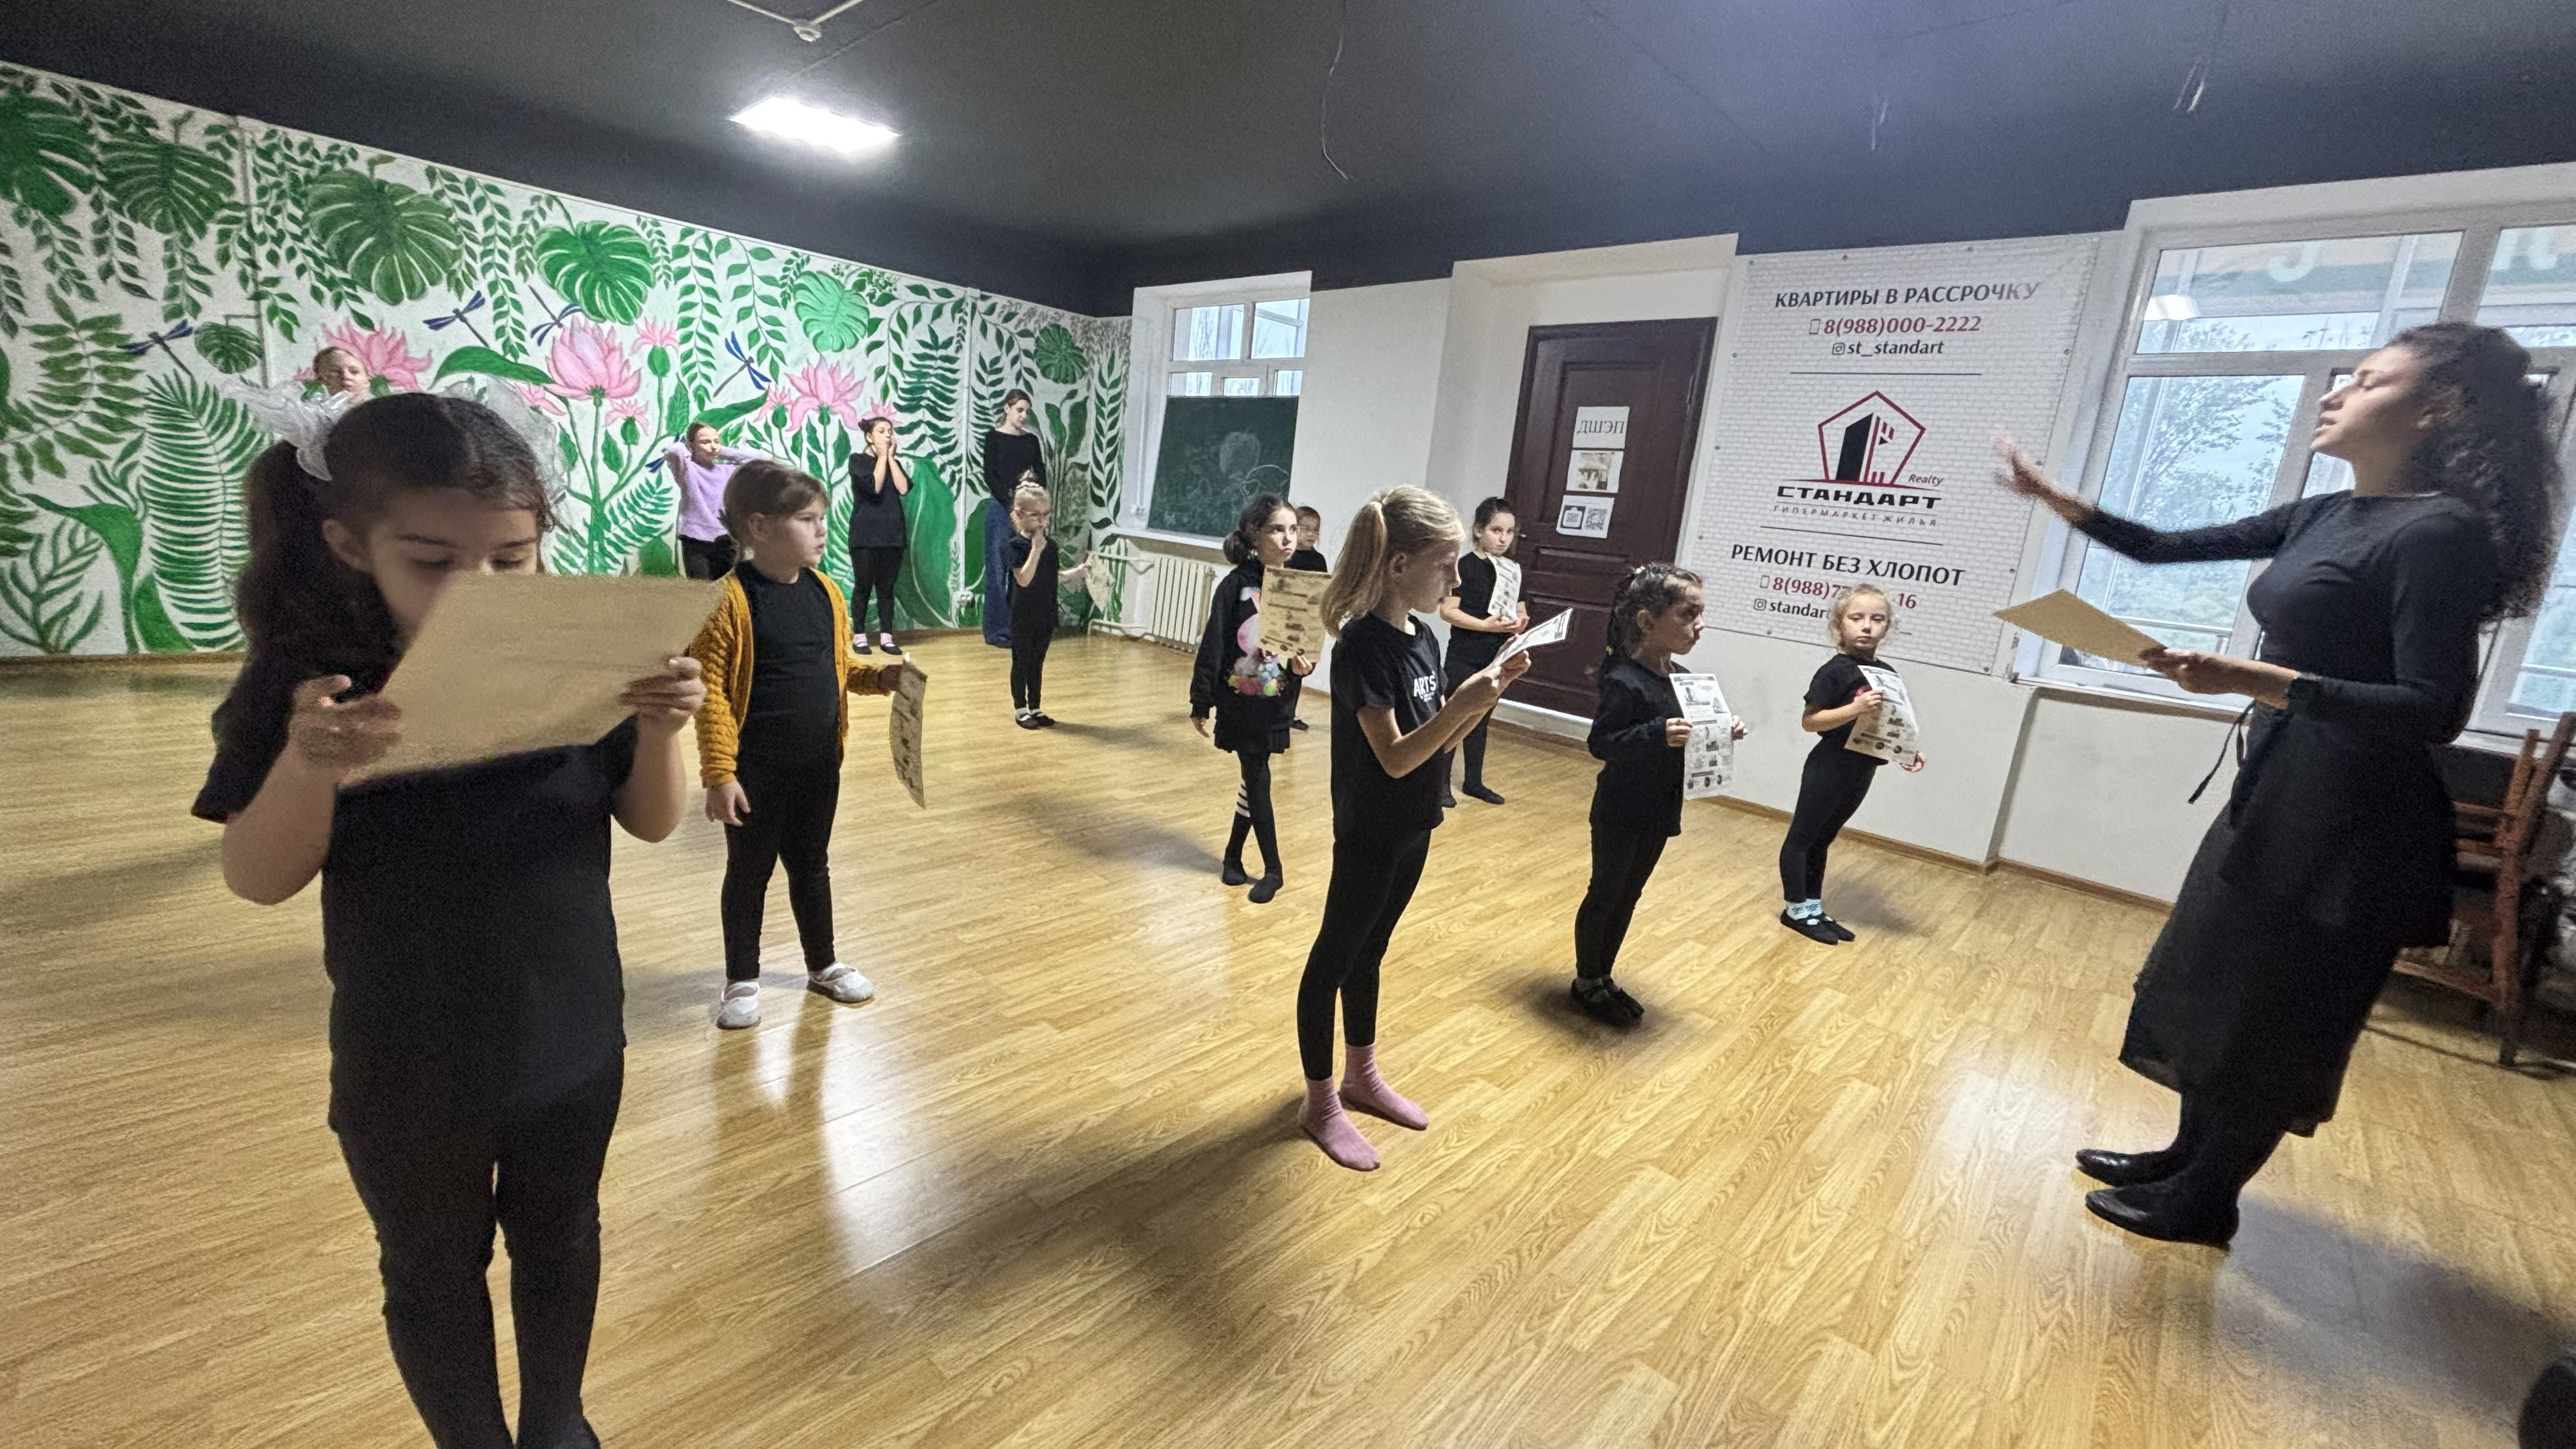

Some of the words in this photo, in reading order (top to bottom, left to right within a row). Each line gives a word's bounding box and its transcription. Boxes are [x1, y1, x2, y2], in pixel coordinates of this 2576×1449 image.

[1775, 289, 1879, 307] КВАРТИРЫ
[1885, 289, 1898, 304] В
[1905, 282, 2039, 303] РАССРОЧКУ
[1824, 316, 1981, 336] 8(988)000-2222
[1847, 340, 1944, 356] st_standart
[1577, 420, 1625, 434] ДШЭП
[1908, 473, 1944, 487] Realty
[1777, 486, 1942, 509] СТАНДАРТ
[1774, 505, 1877, 521] ГИПЕРМАРКЕТ
[1883, 514, 1936, 526] ЖИЛЬЯ
[1731, 544, 1818, 568] РЕМОНТ
[1823, 554, 1860, 574] БЕЗ
[1866, 559, 1966, 586] ХЛОПОТ
